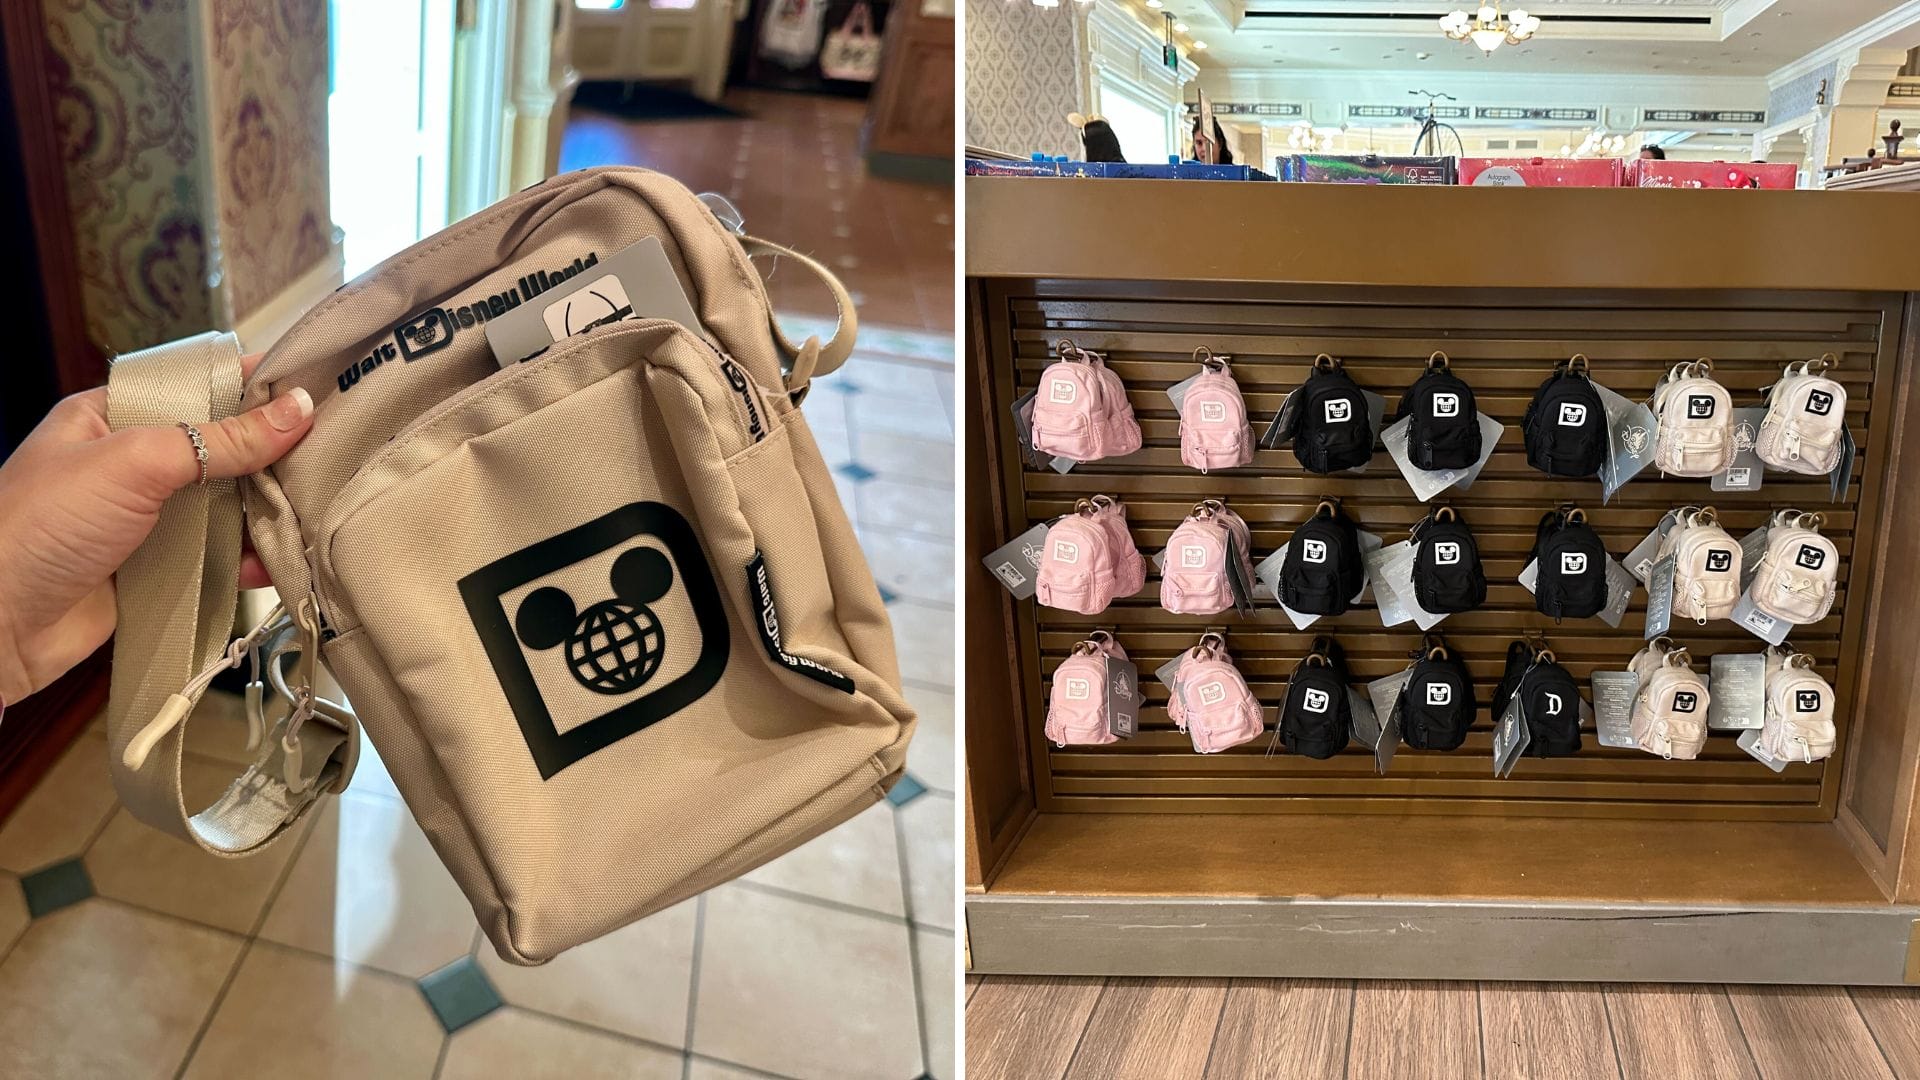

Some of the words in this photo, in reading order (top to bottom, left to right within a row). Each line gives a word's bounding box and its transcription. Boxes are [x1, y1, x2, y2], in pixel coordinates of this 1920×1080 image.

[338, 342, 397, 393] Walt
[394, 288, 523, 363] Disney
[757, 565, 774, 606] Walt
[763, 601, 798, 665] Disey
